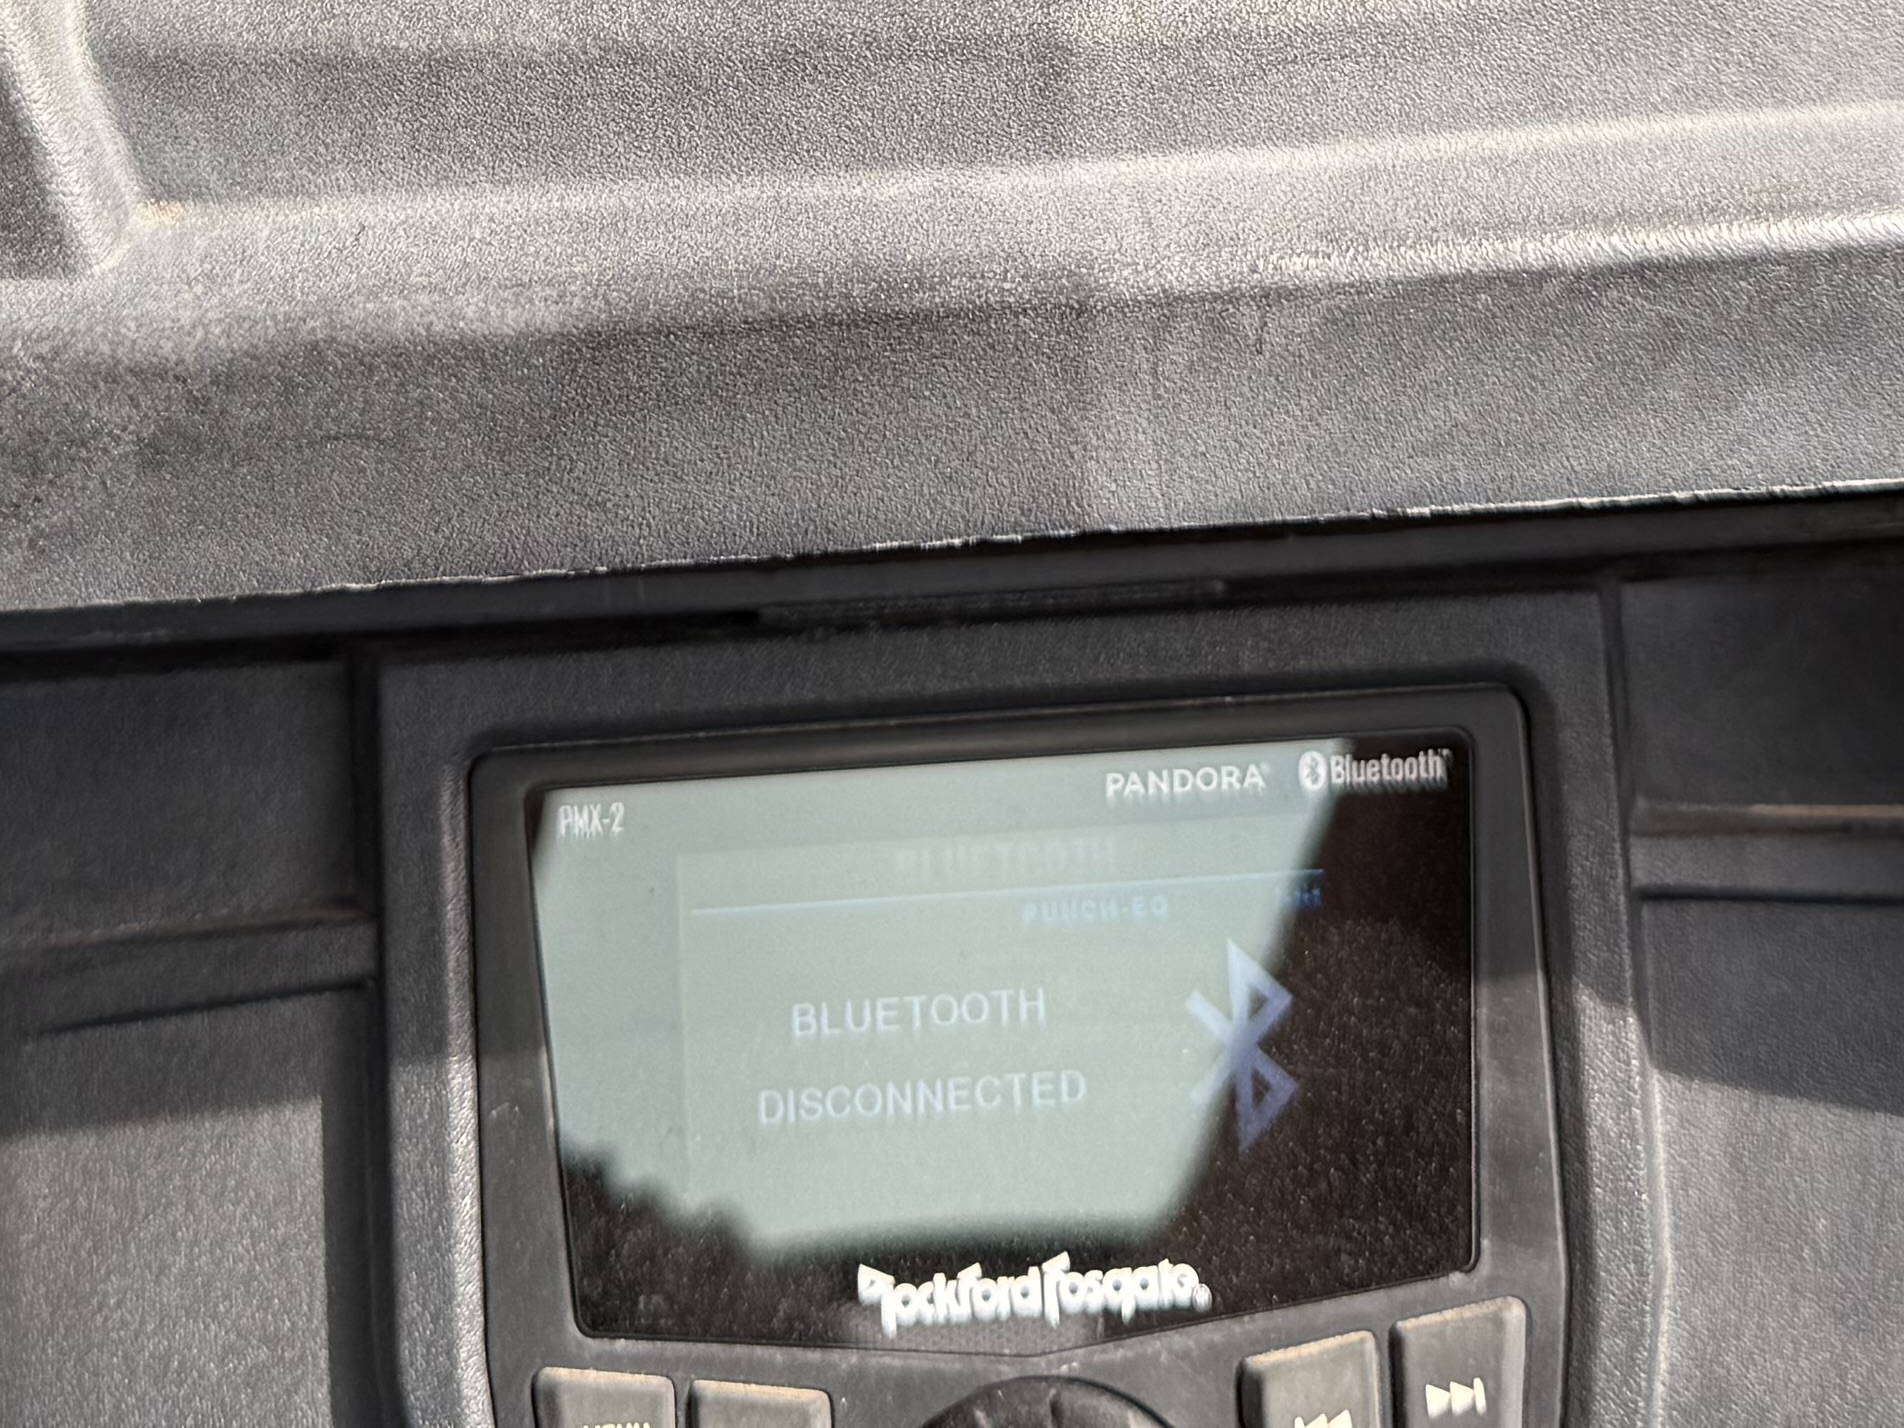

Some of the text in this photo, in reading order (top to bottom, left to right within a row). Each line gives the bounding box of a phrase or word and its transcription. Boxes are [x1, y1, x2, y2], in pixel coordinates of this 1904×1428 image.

[1105, 763, 1268, 798] PANDORA
[558, 801, 625, 839] PMX-2
[791, 986, 1046, 1037] BLUETOOTH
[757, 1069, 1089, 1126] DISCONNECTED
